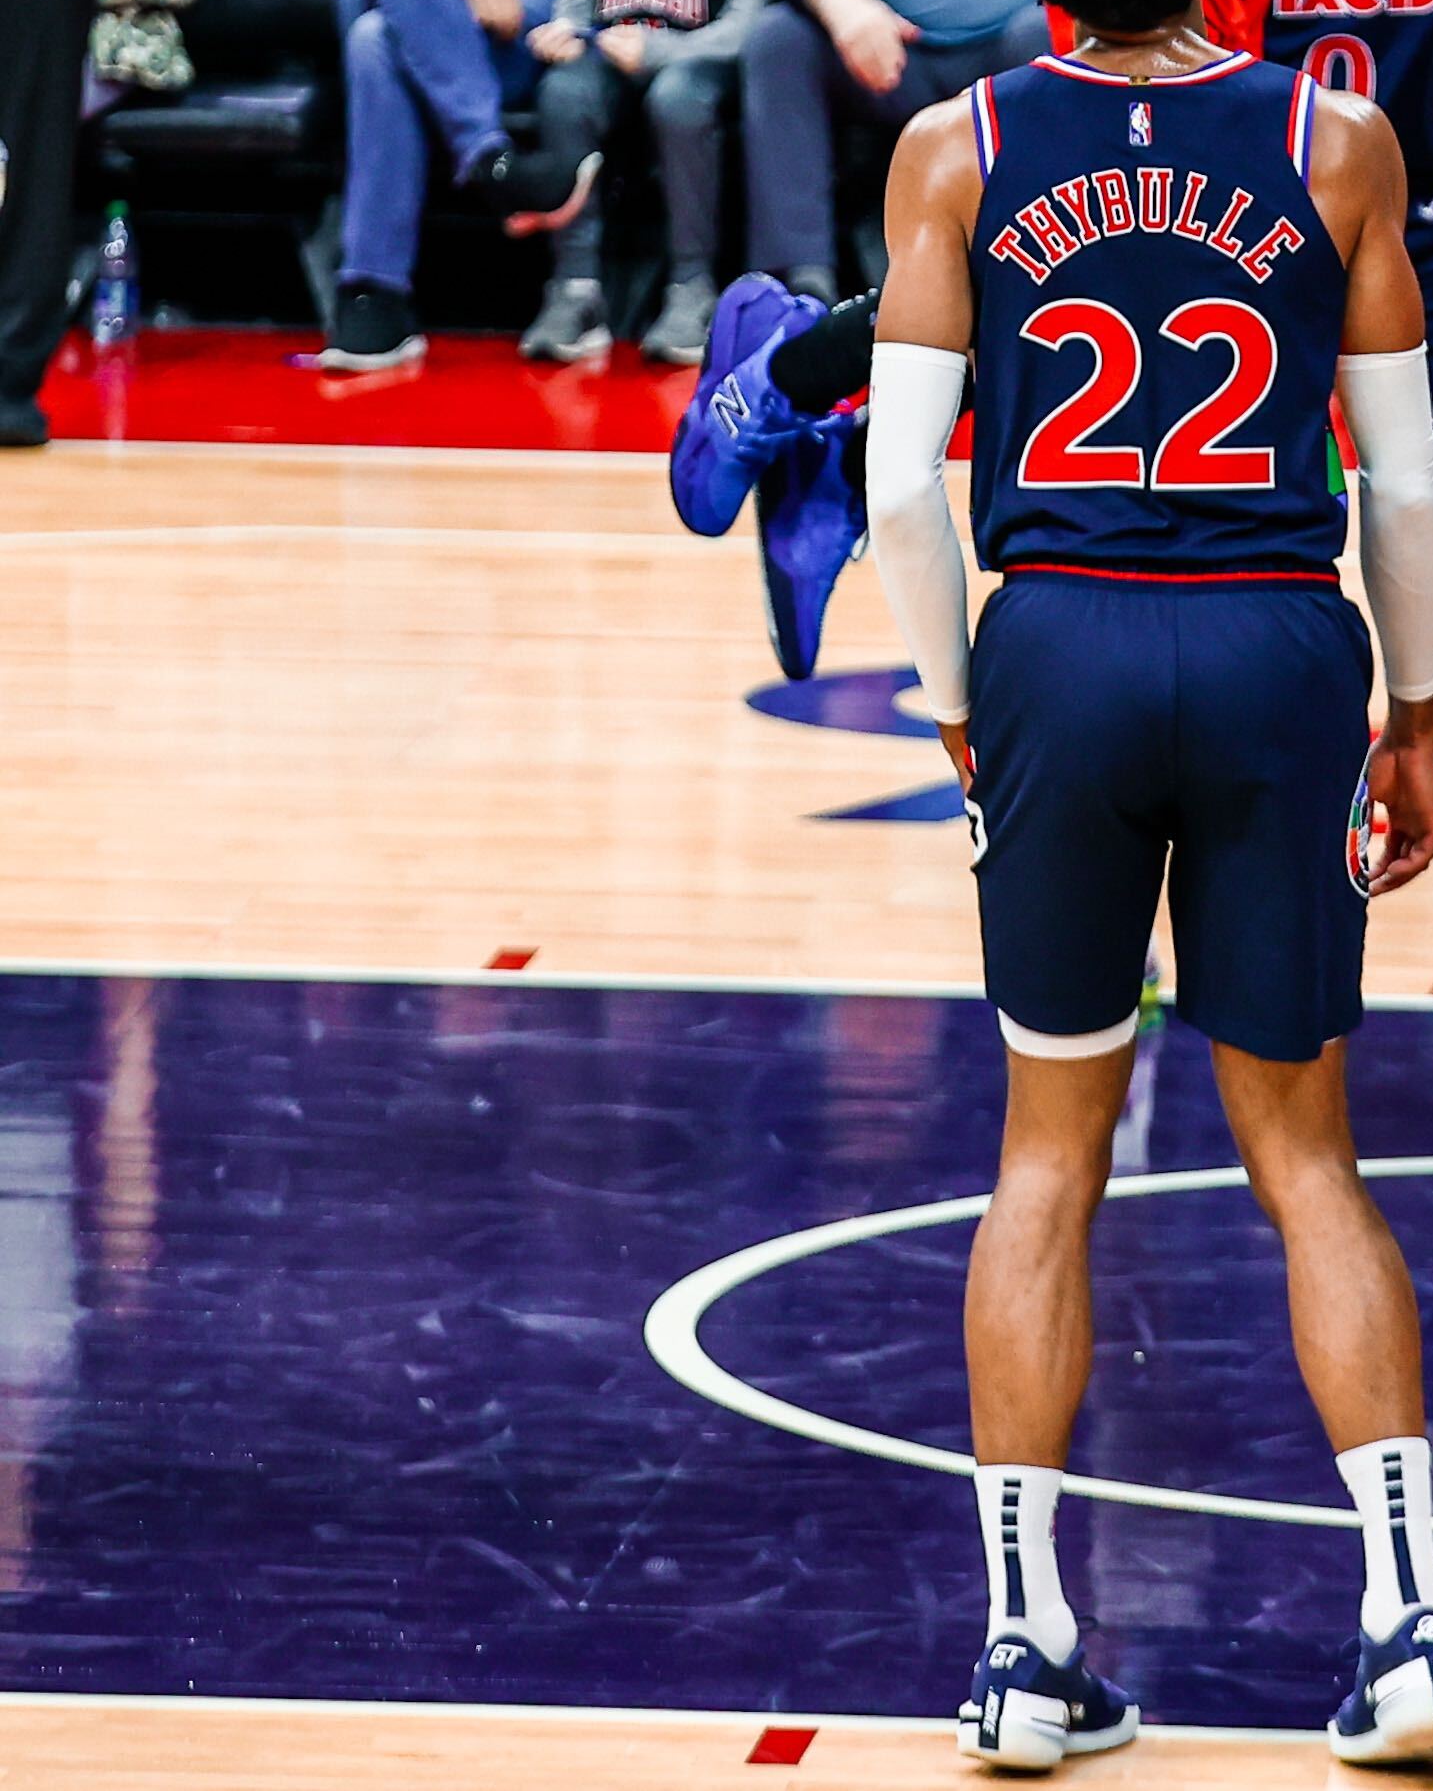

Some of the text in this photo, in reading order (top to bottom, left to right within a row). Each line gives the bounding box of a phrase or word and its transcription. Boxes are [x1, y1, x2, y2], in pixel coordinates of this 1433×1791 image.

[988, 167, 1305, 286] THYBULLE
[709, 372, 752, 441] N
[1017, 297, 1279, 492] 22
